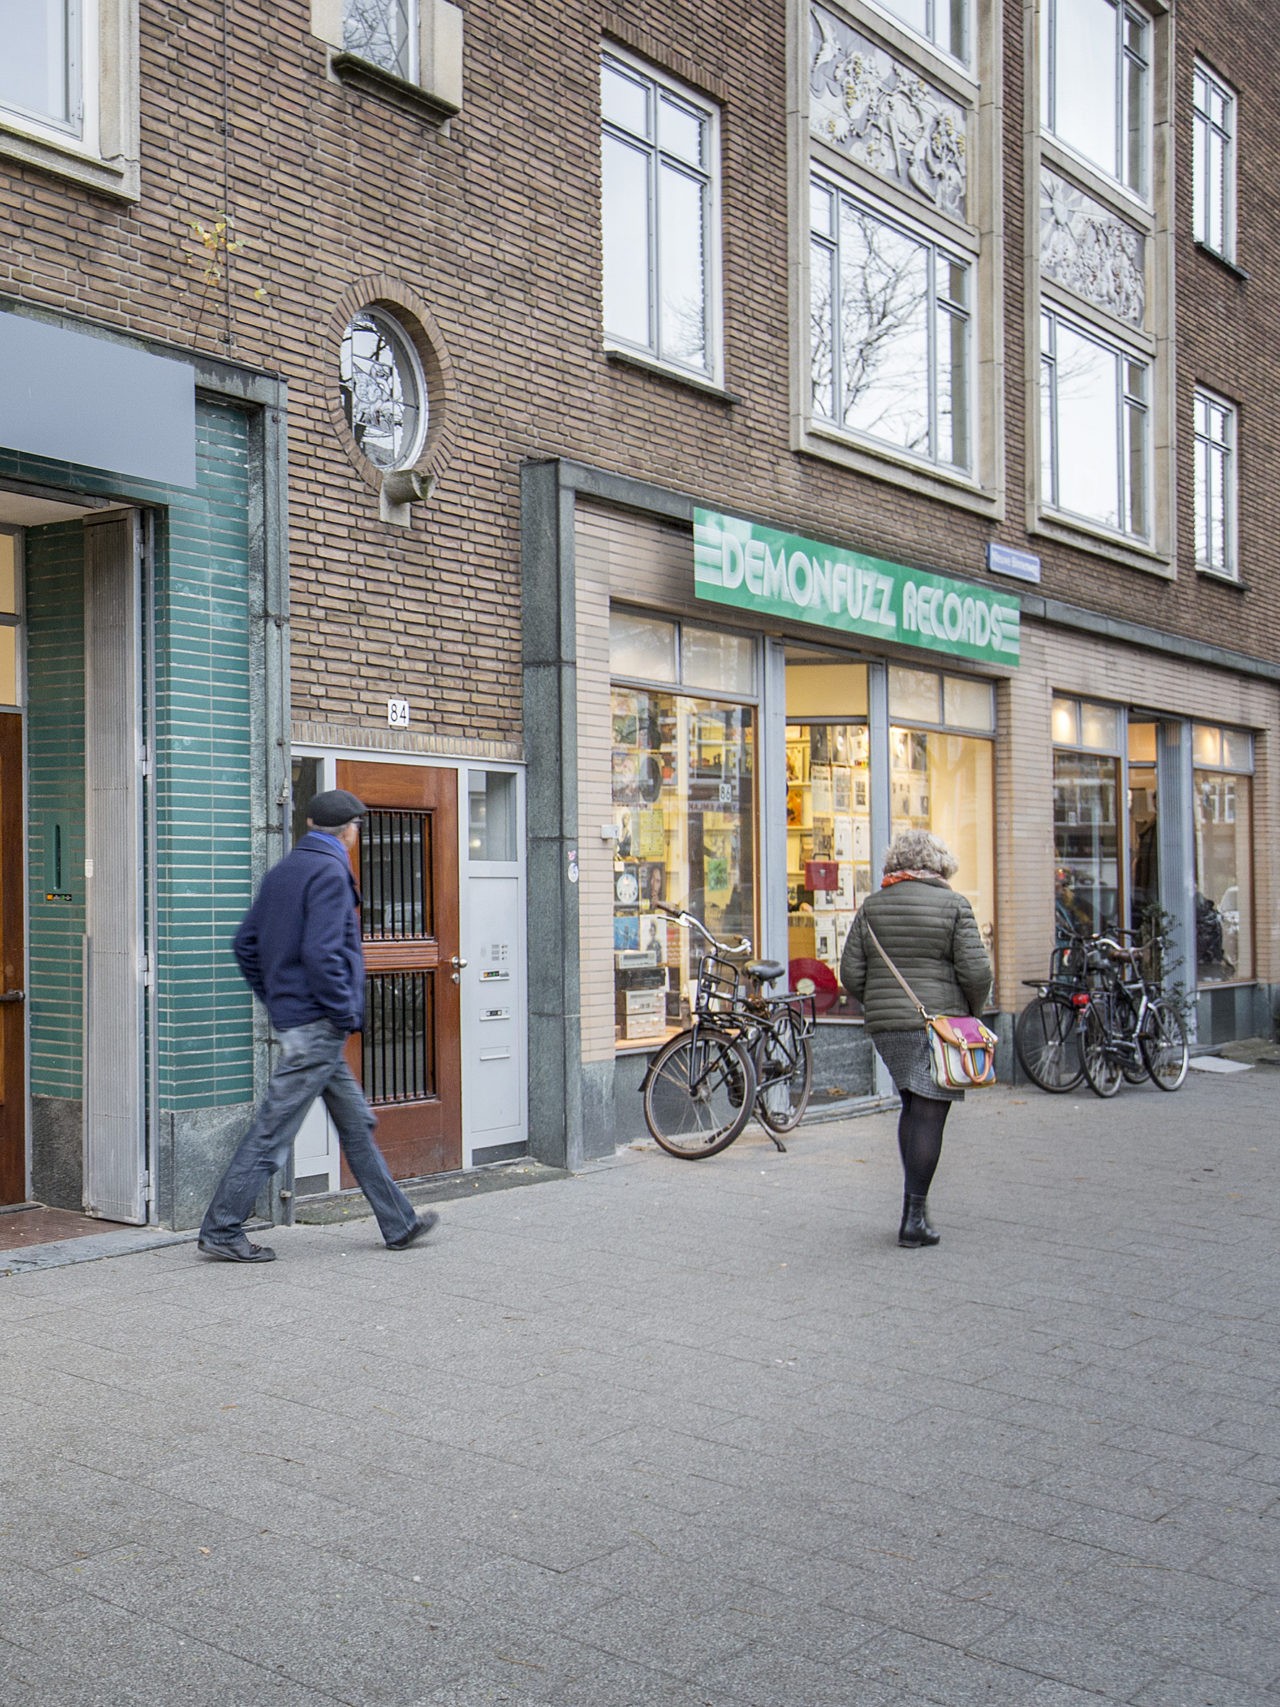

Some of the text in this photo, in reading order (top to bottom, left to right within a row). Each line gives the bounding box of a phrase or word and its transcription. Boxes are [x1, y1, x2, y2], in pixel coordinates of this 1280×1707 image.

[720, 532, 1004, 652] DEMONFUZZ RECORDS
[390, 703, 407, 724] 84
